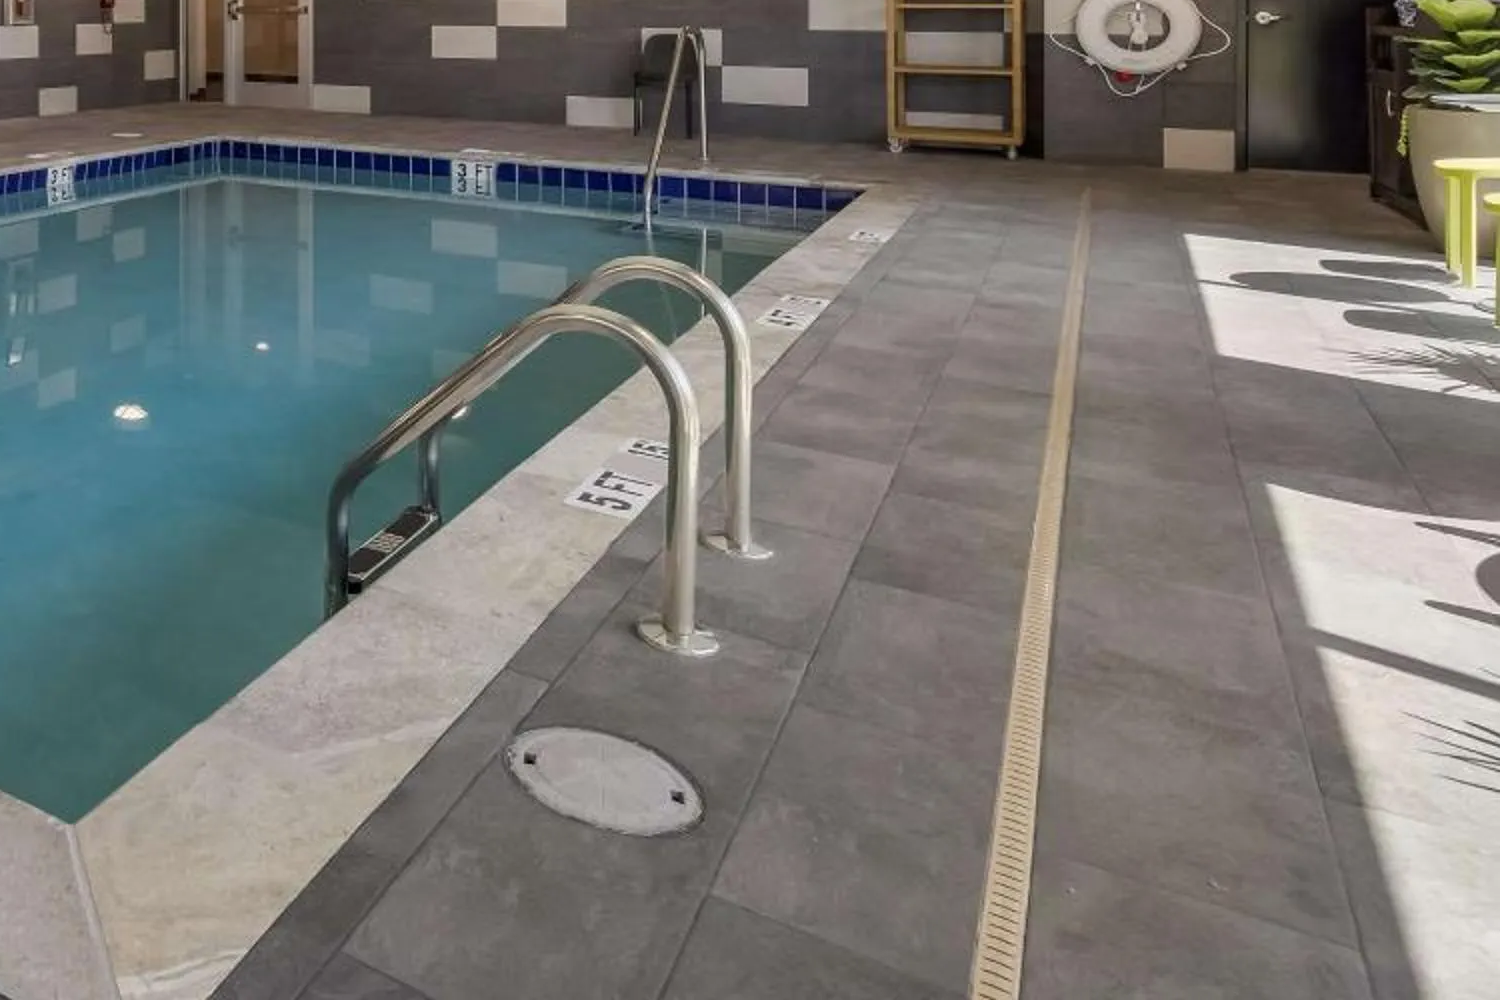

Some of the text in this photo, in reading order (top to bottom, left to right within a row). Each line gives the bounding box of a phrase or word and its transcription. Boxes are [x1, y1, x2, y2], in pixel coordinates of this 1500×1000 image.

[458, 163, 493, 179] 3 FT
[593, 471, 653, 497] FT
[576, 491, 633, 510] 5
